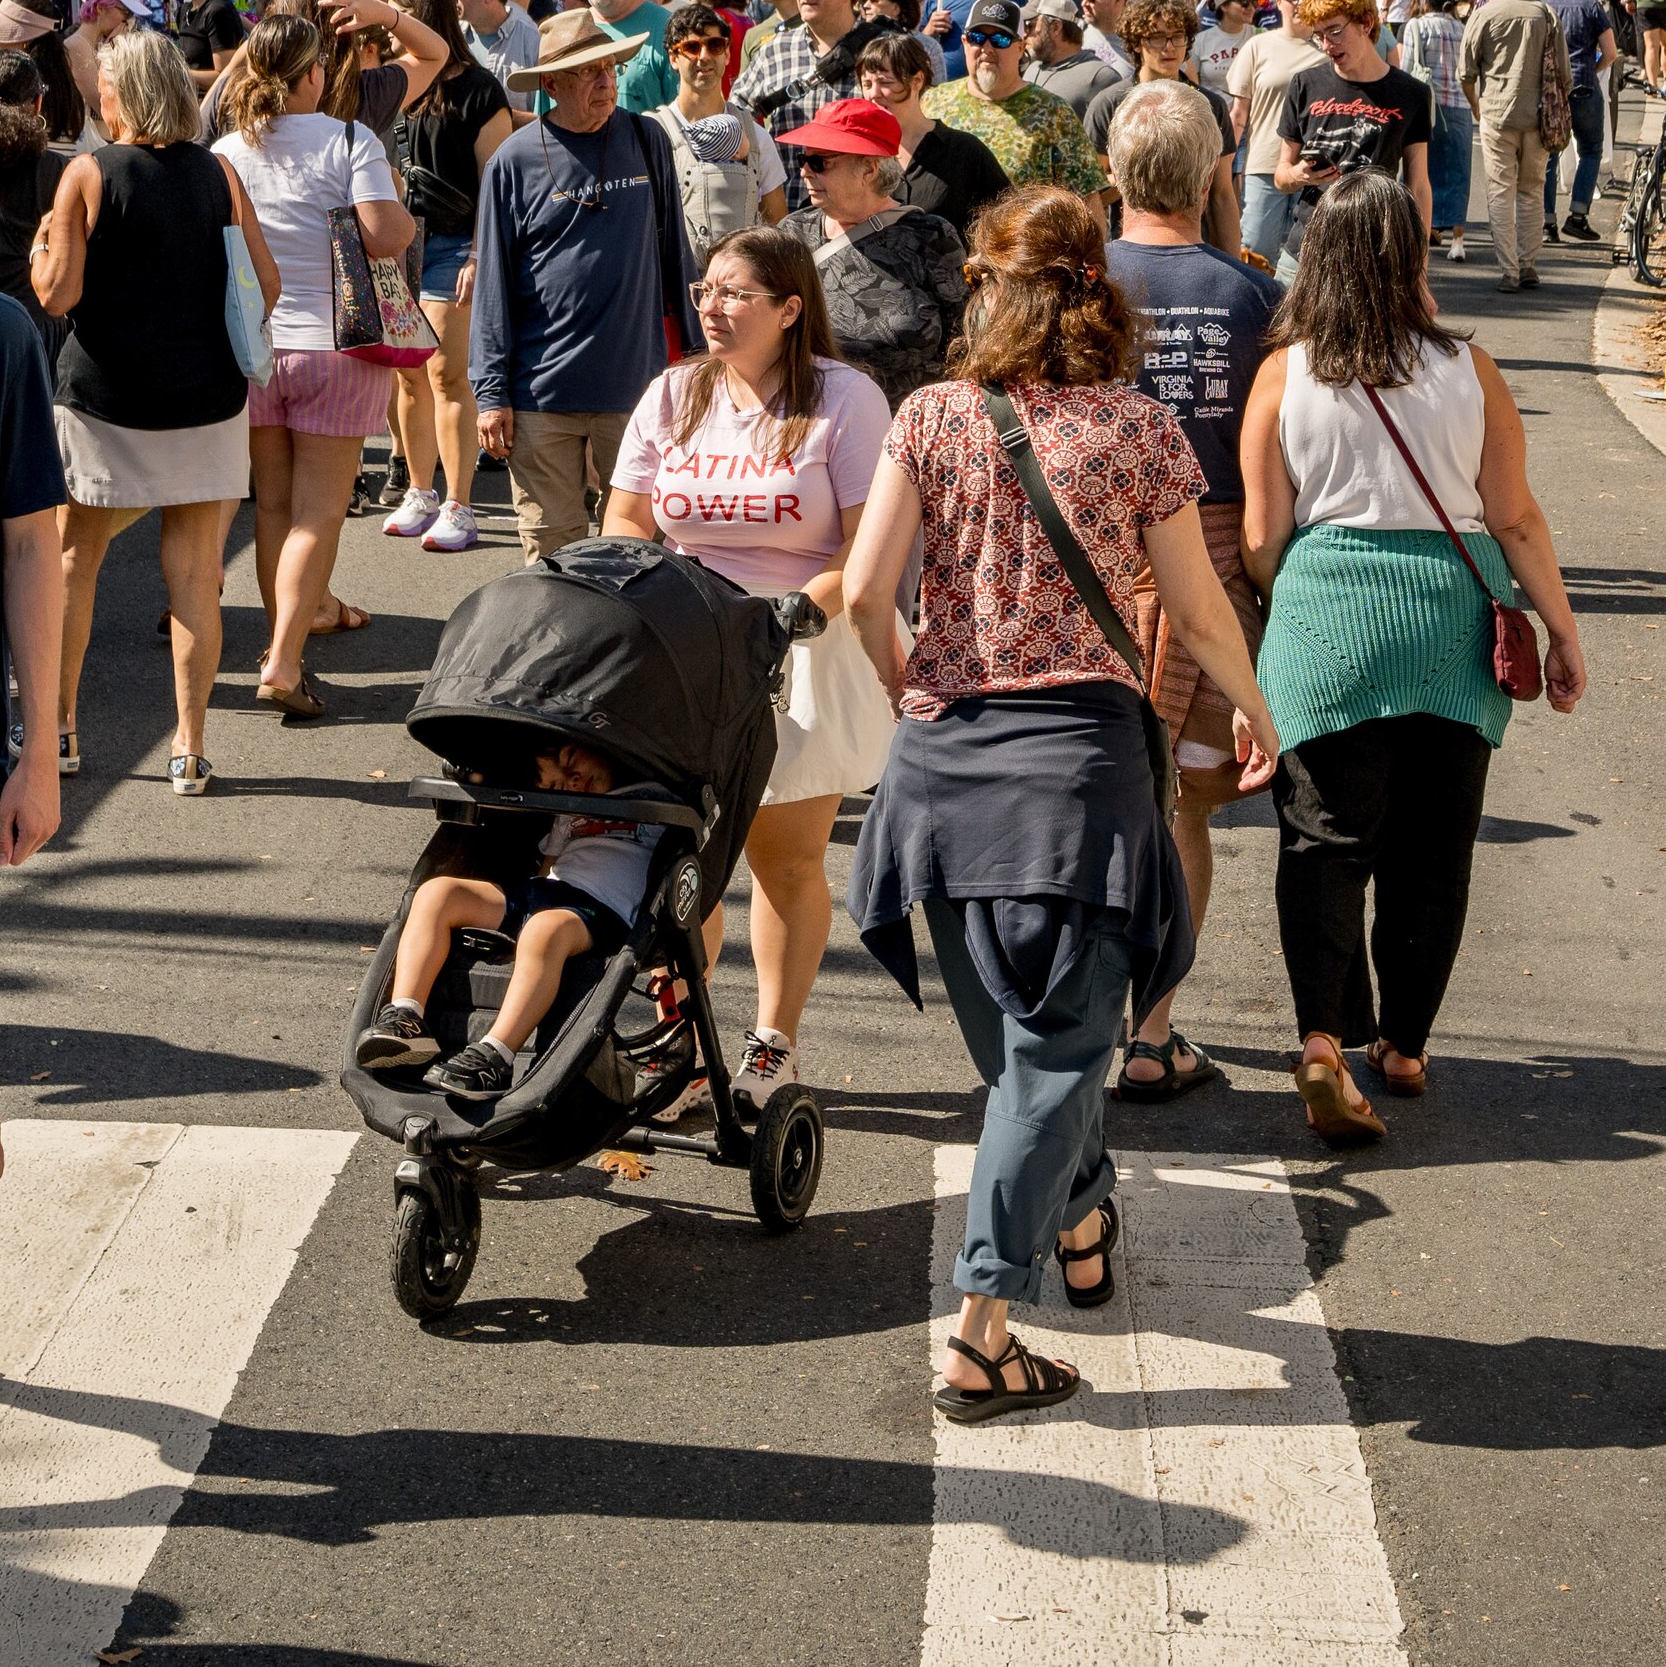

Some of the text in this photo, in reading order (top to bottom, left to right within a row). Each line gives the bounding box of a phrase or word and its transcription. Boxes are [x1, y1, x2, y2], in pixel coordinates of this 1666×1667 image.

[1309, 97, 1404, 121] Bloodsport
[569, 177, 636, 198] HANG TEN
[1170, 307, 1199, 316] DUATHLON
[1197, 326, 1220, 338] Page
[1201, 333, 1230, 346] Valley
[1193, 358, 1231, 368] HAWKSBILL
[1151, 375, 1194, 384] VIRGINIA
[1205, 376, 1229, 392] LURAY
[1159, 383, 1188, 392] IS FOR
[663, 446, 796, 480] LATINA
[653, 484, 802, 524] POWER
